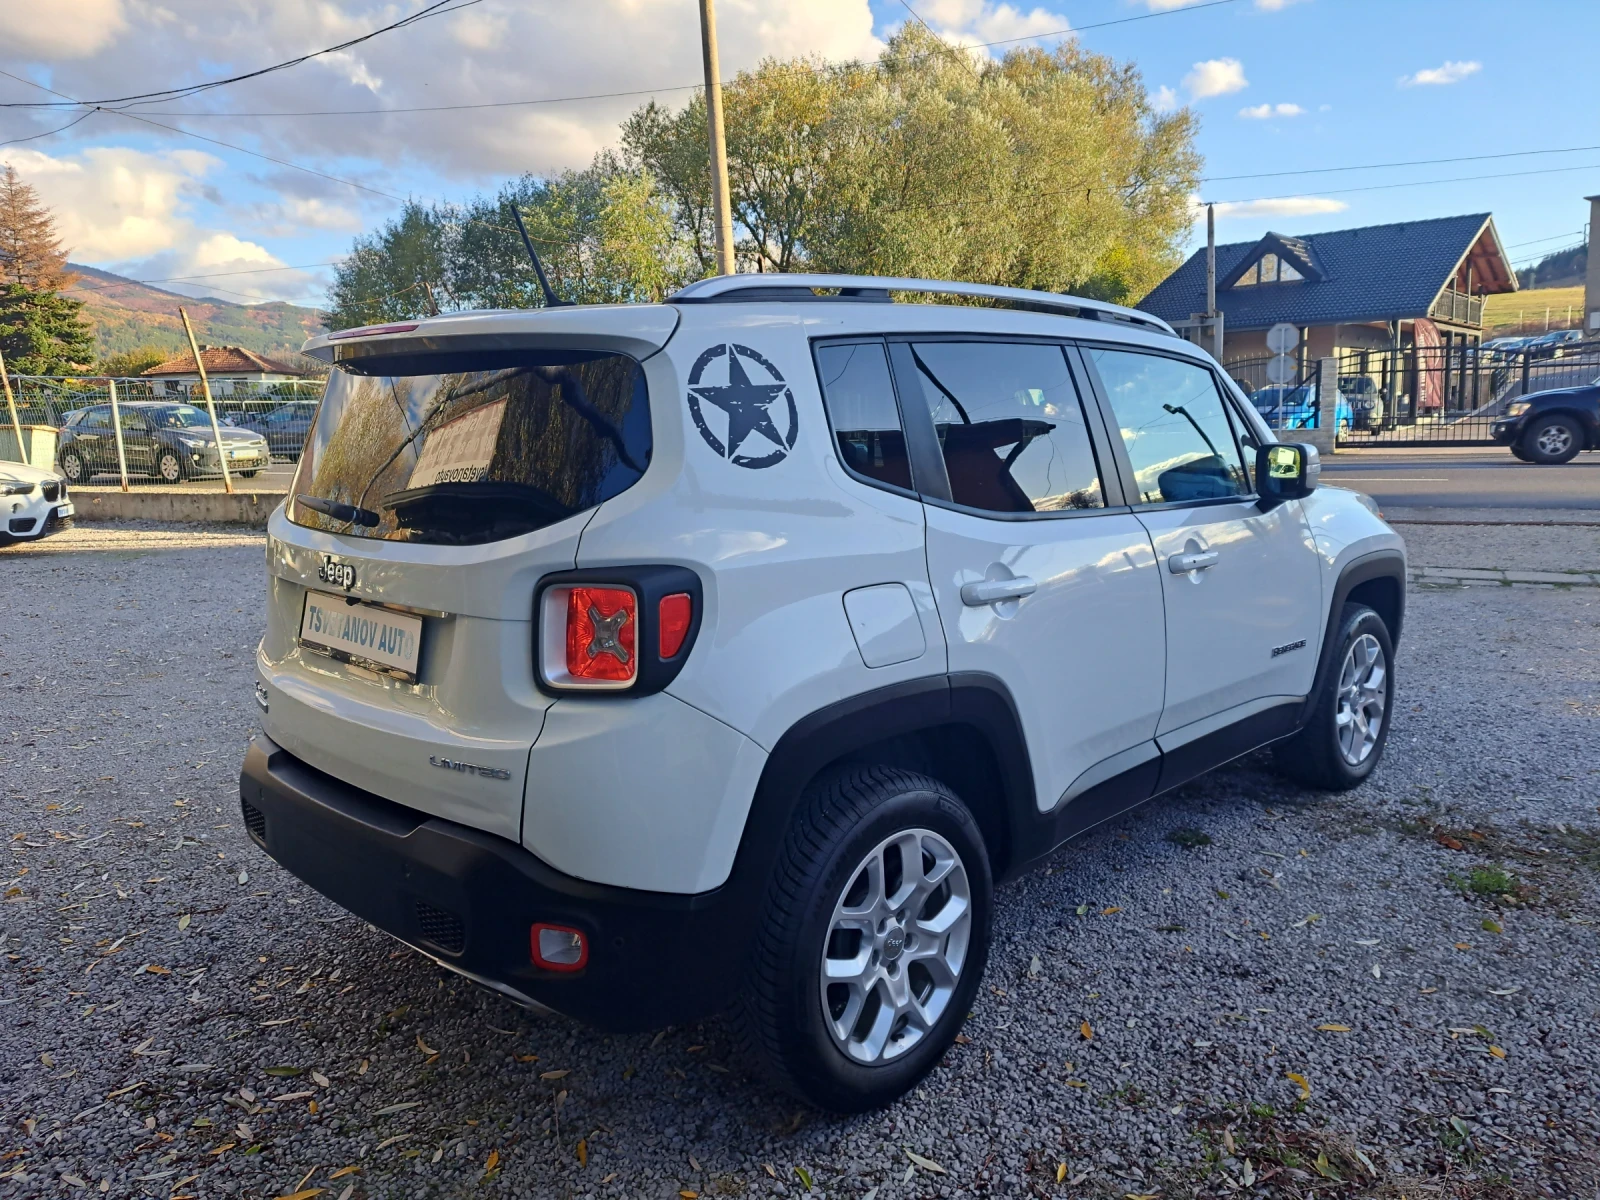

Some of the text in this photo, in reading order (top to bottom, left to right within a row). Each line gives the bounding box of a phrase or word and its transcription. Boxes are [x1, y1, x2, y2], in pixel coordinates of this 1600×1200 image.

[318, 555, 356, 592] Jeep
[309, 605, 415, 660] TSVETANOV AUTO
[428, 754, 511, 780] LIMITED
